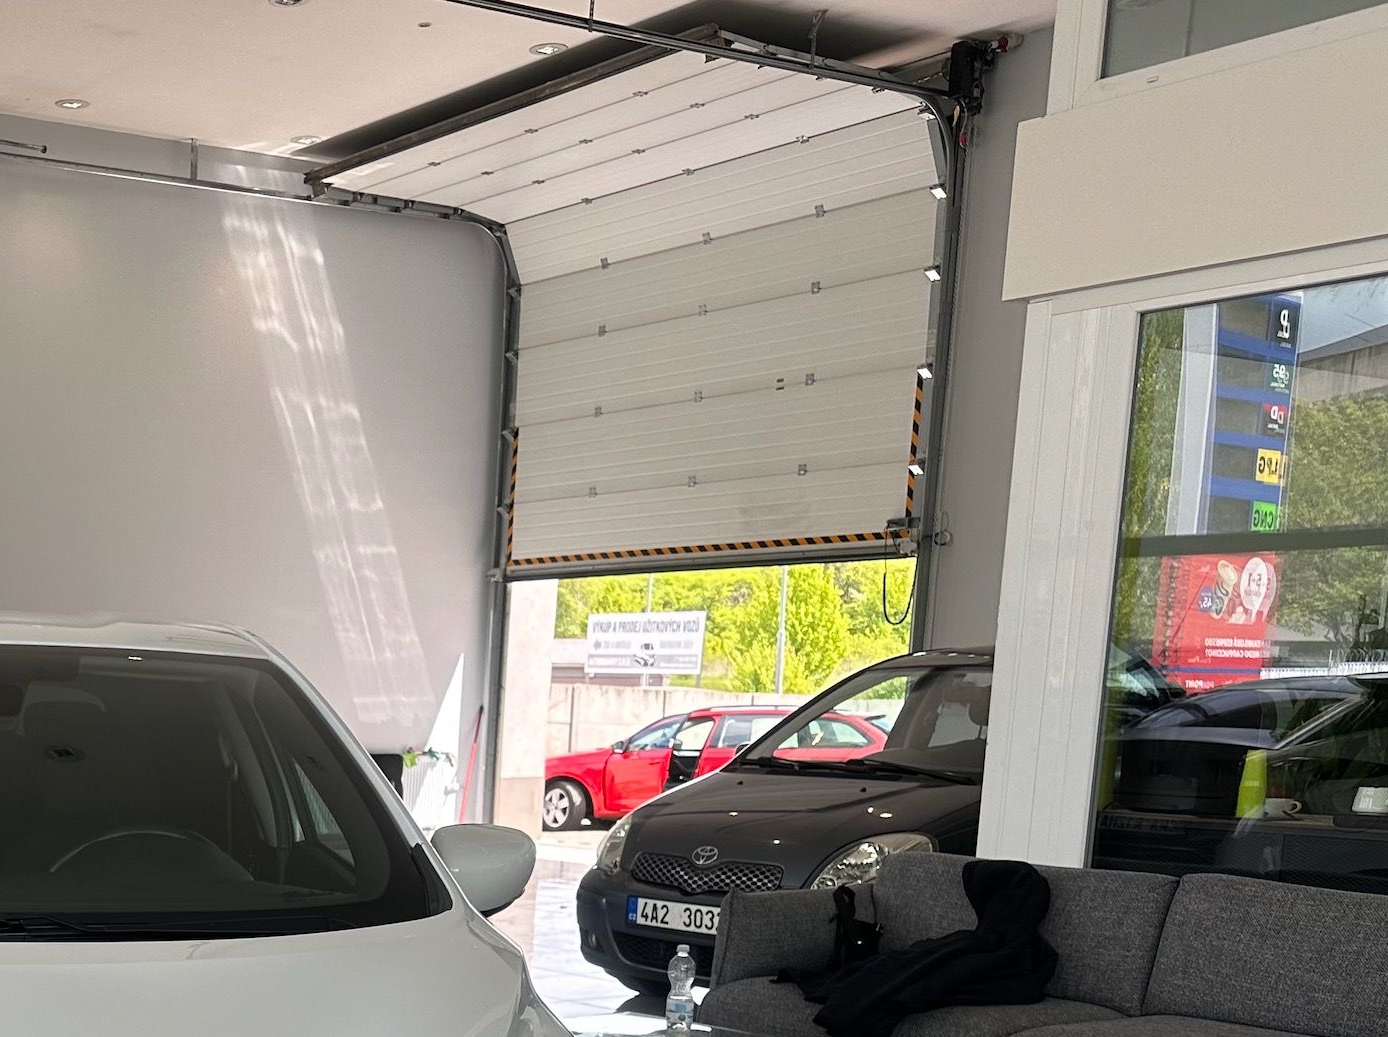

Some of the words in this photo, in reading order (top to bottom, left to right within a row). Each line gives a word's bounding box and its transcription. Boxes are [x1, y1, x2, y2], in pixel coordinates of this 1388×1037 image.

[618, 620, 641, 633] PRODEJ
[640, 901, 670, 925] 4A2
[683, 907, 720, 931] 303
